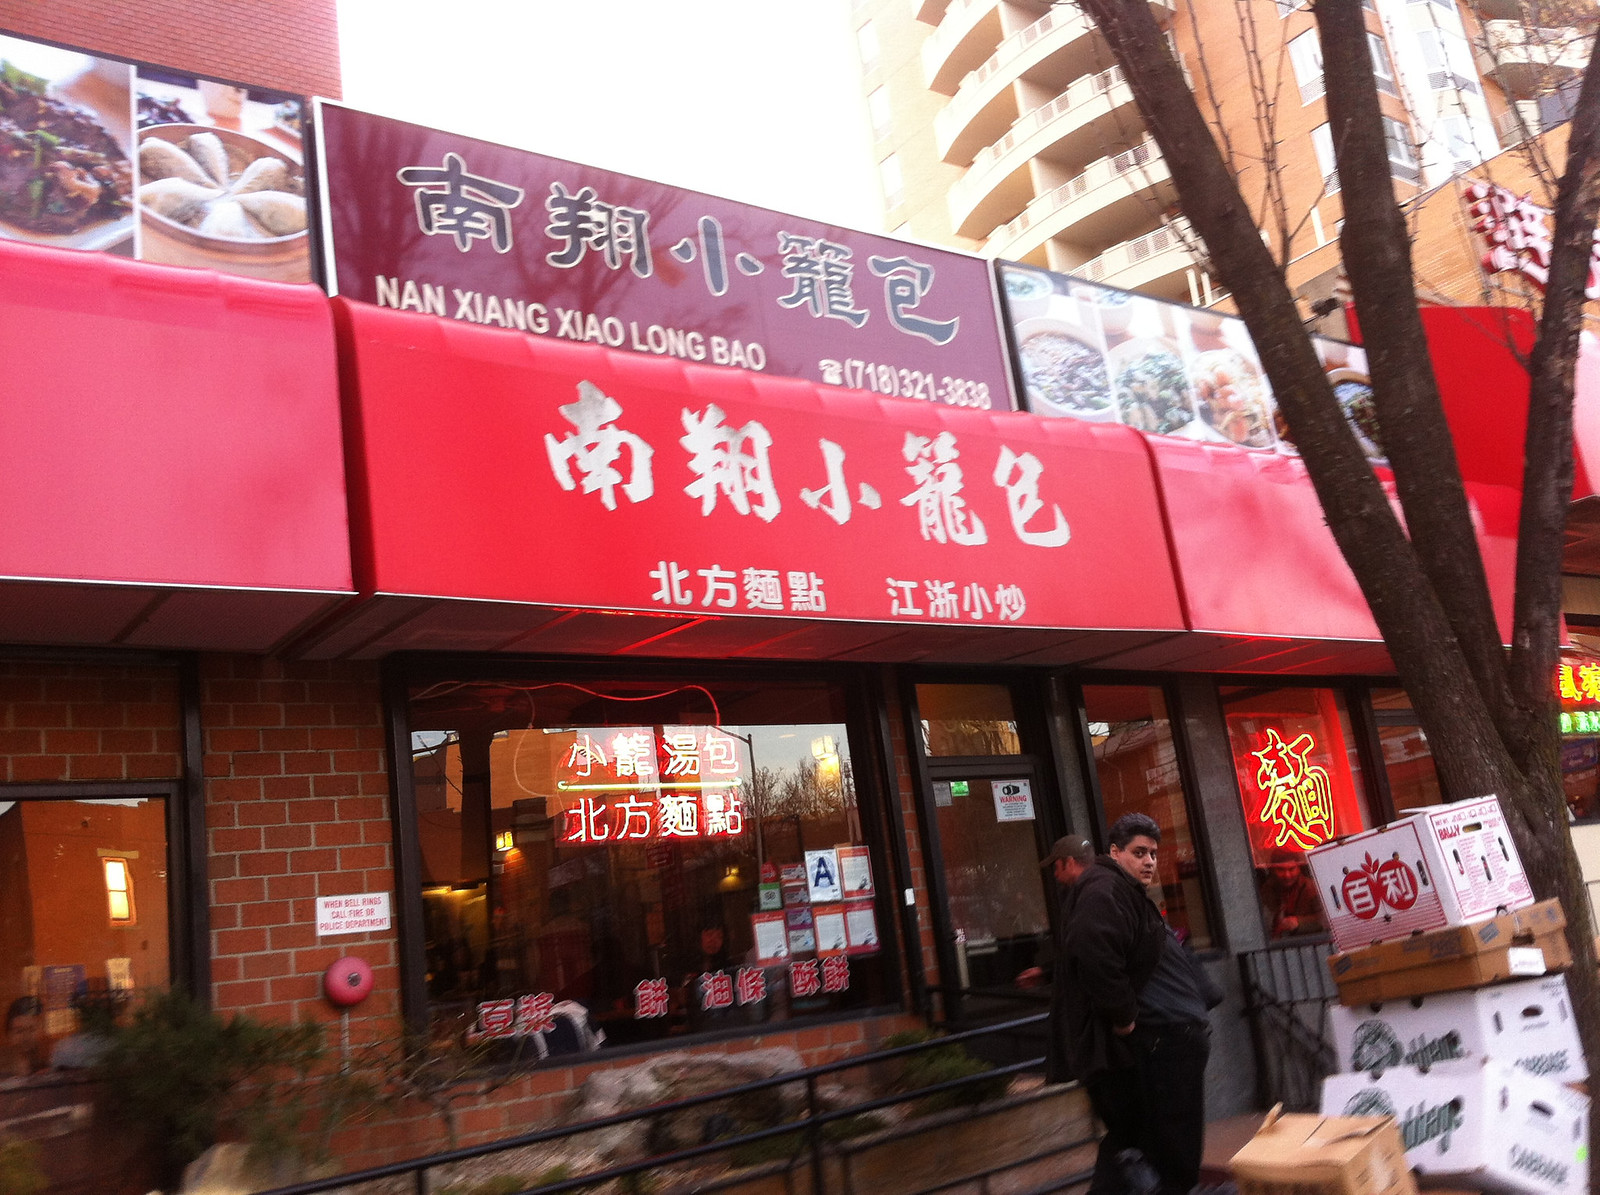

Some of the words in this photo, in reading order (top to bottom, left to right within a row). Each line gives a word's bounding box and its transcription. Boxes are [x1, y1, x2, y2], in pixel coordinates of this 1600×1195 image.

[396, 151, 961, 346] 南翔小籠包
[375, 274, 447, 317] NAN
[452, 288, 550, 335] XIANG
[554, 307, 625, 348] XIAO
[631, 320, 706, 361] LONG
[710, 335, 767, 371] BAO
[844, 357, 992, 410] (718)321-3838
[543, 380, 1072, 549] 南翔小籠包
[648, 560, 827, 613] 北方麵點
[885, 576, 1026, 622] 江浙小炒
[567, 732, 739, 777] 小籠湯包
[567, 794, 743, 842] 北方麵點
[1000, 795, 1028, 803] WARNING
[814, 856, 835, 888] A
[1346, 865, 1416, 914] 百利
[320, 920, 344, 931] POLICE
[345, 917, 388, 929] DEPARTMENT
[324, 900, 343, 909] WHEN
[345, 898, 361, 907] BELL
[362, 896, 382, 906] RINGS
[331, 910, 348, 919] CALL
[349, 908, 364, 918] FIRE
[365, 907, 376, 917] OR
